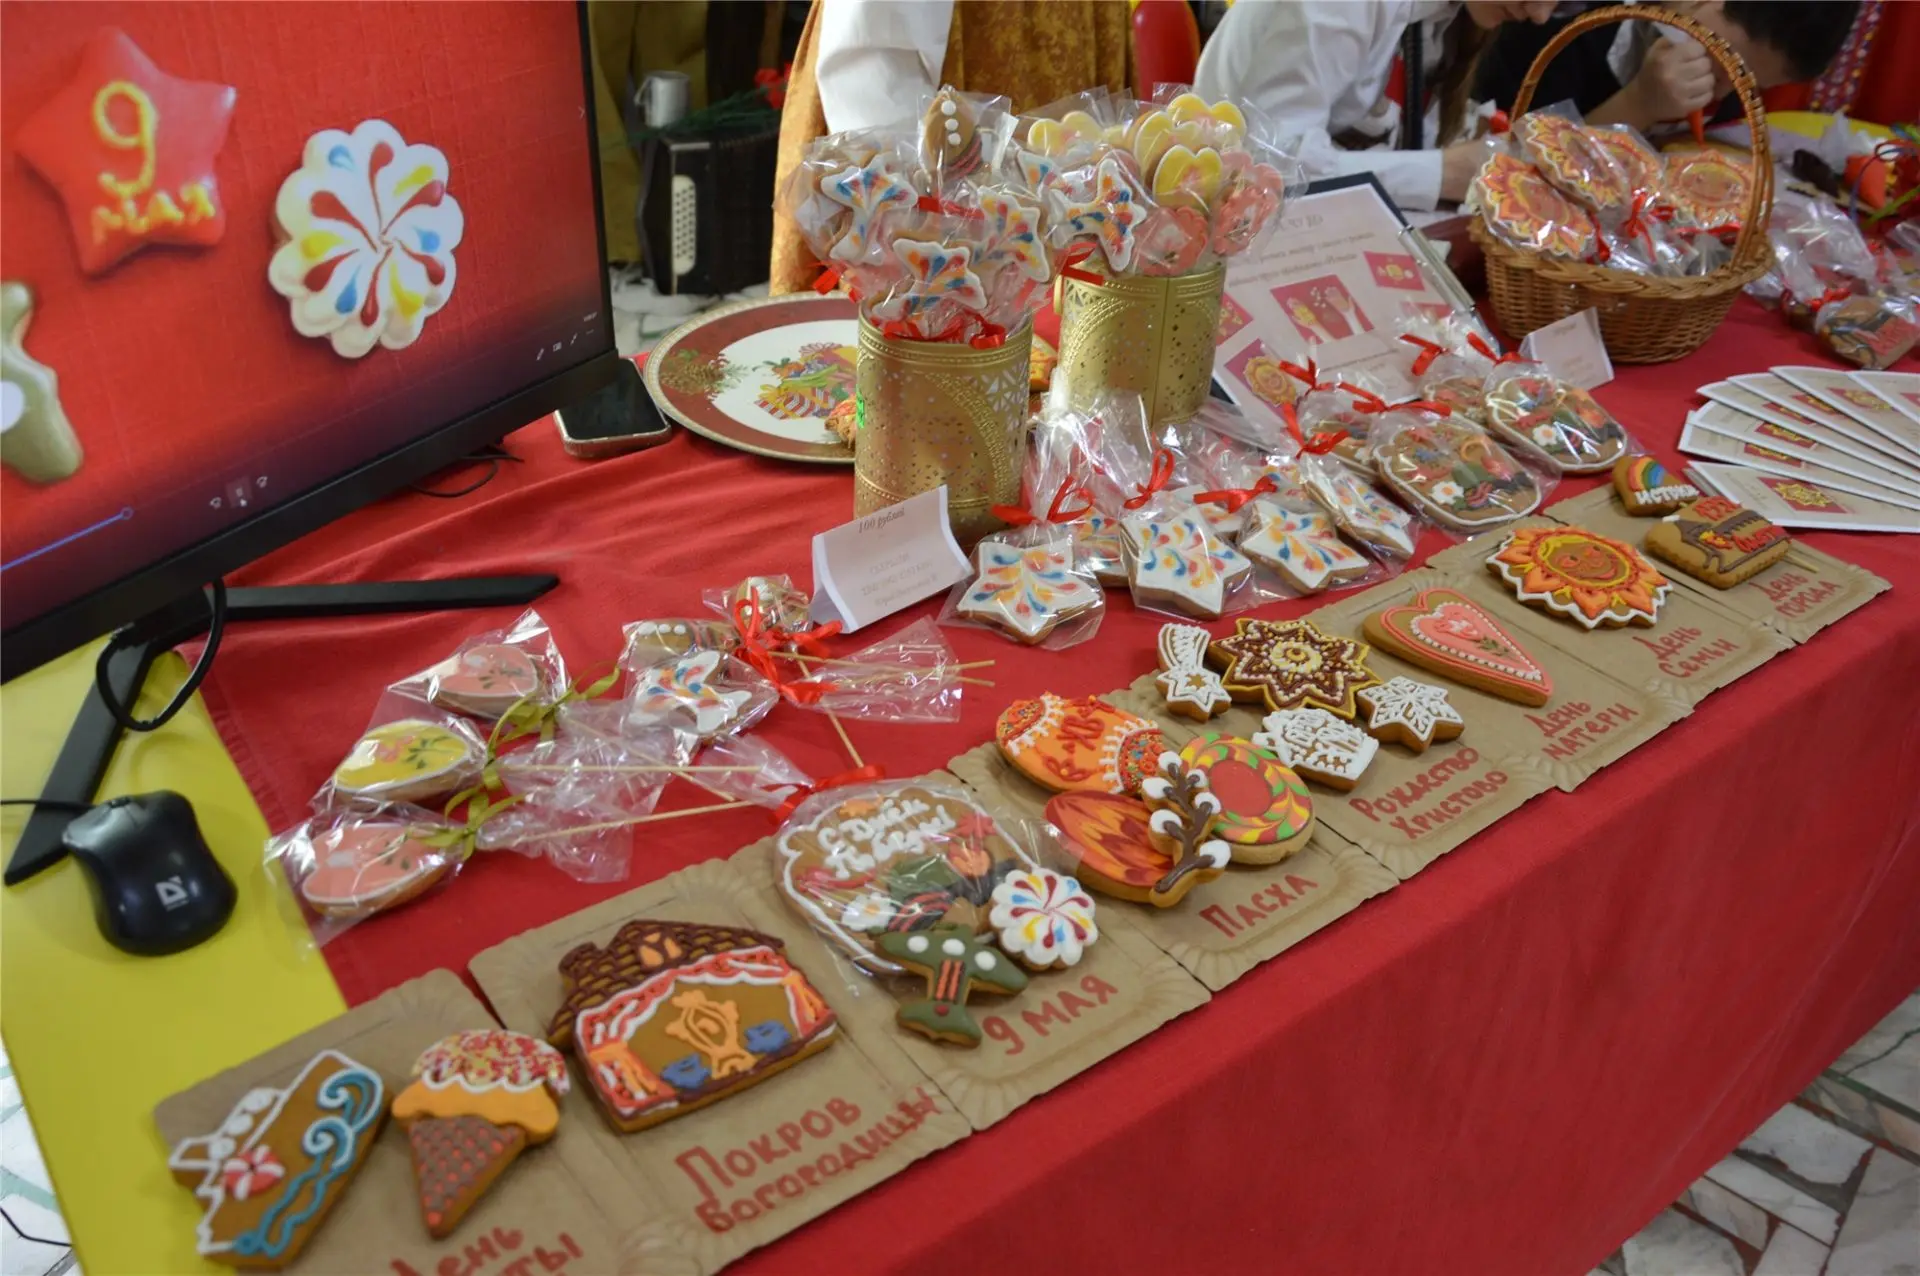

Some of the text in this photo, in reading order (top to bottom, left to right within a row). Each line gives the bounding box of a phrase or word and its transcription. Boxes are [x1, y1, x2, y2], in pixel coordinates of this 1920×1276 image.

[92, 80, 158, 196] 9
[1632, 626, 1702, 660] День
[1523, 700, 1592, 738] День
[982, 1014, 1025, 1055] 9
